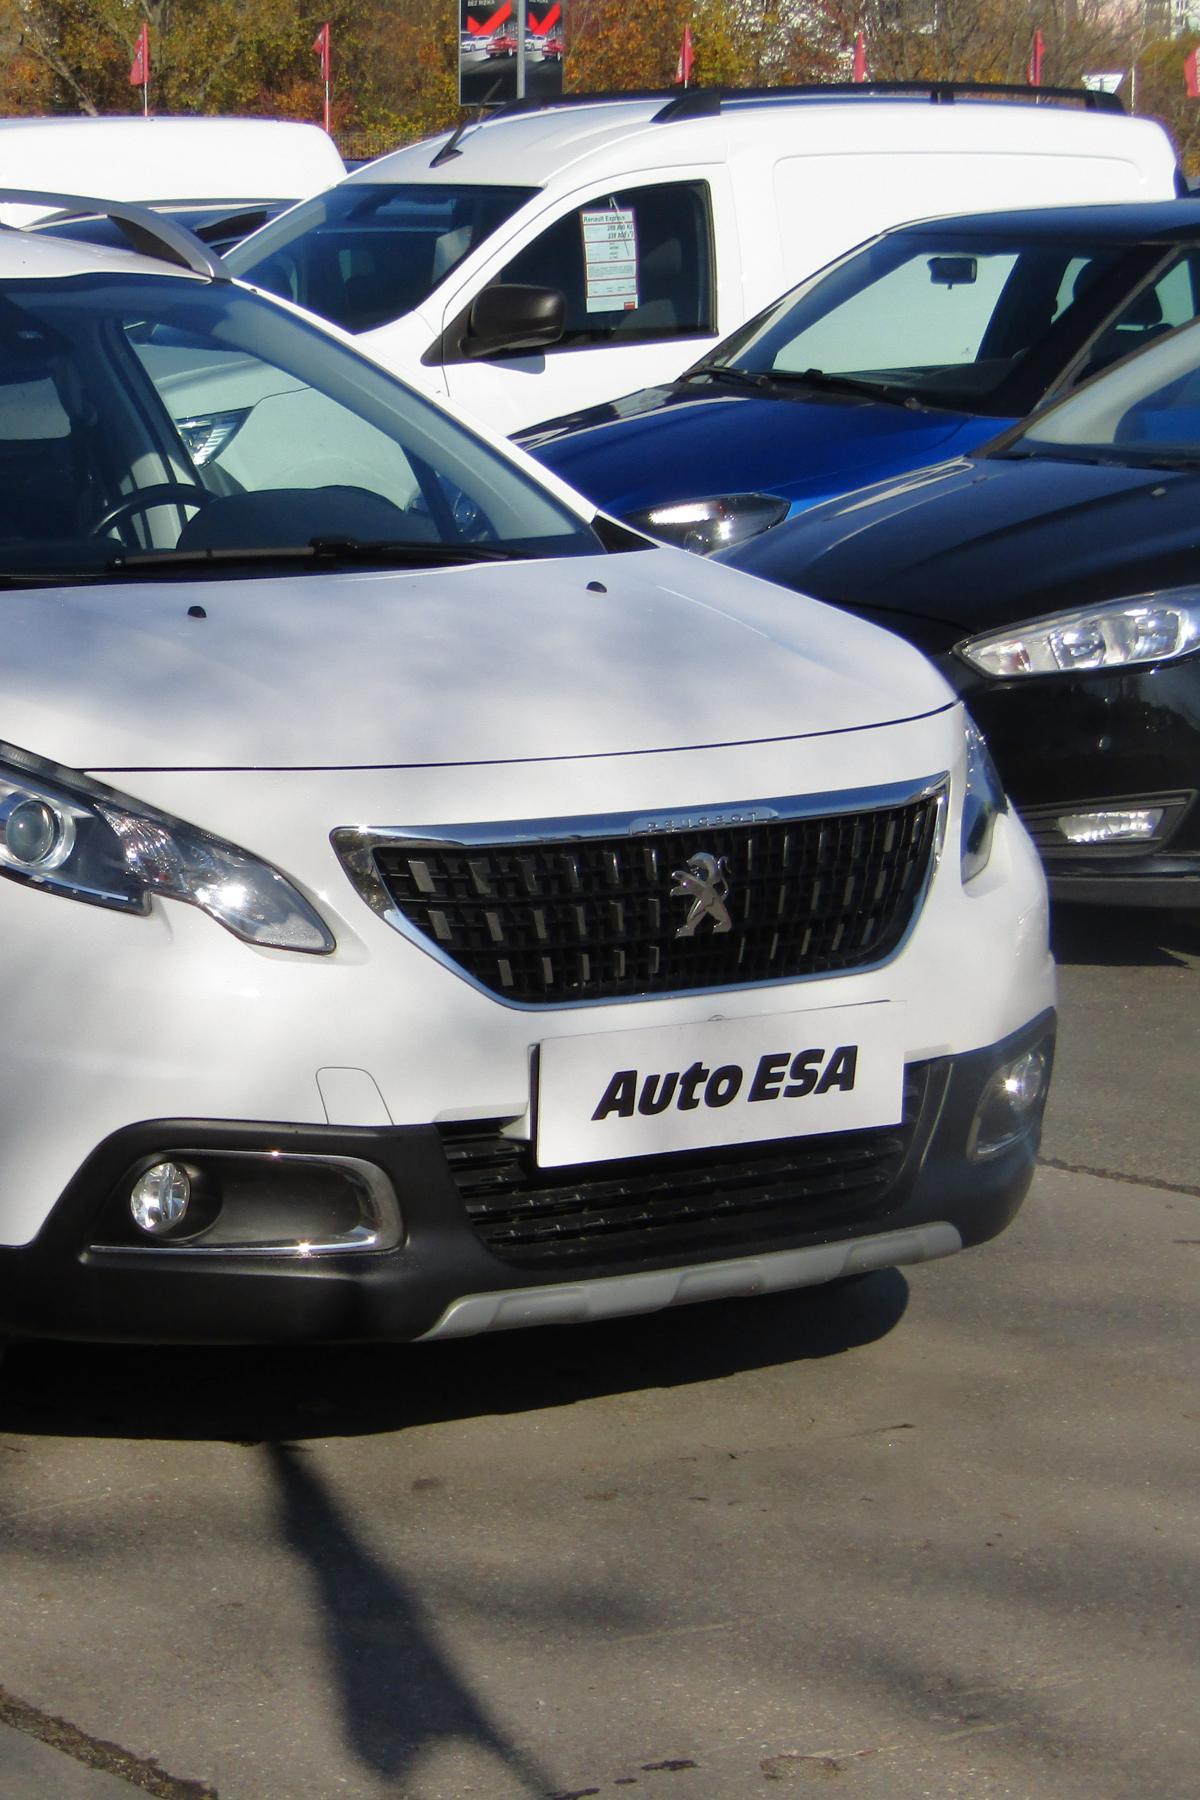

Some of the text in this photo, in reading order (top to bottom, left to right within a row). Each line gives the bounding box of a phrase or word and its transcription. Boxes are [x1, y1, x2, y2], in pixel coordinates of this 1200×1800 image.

[647, 812, 757, 833] PEUGEOT
[590, 1045, 859, 1121] Auto ESA
